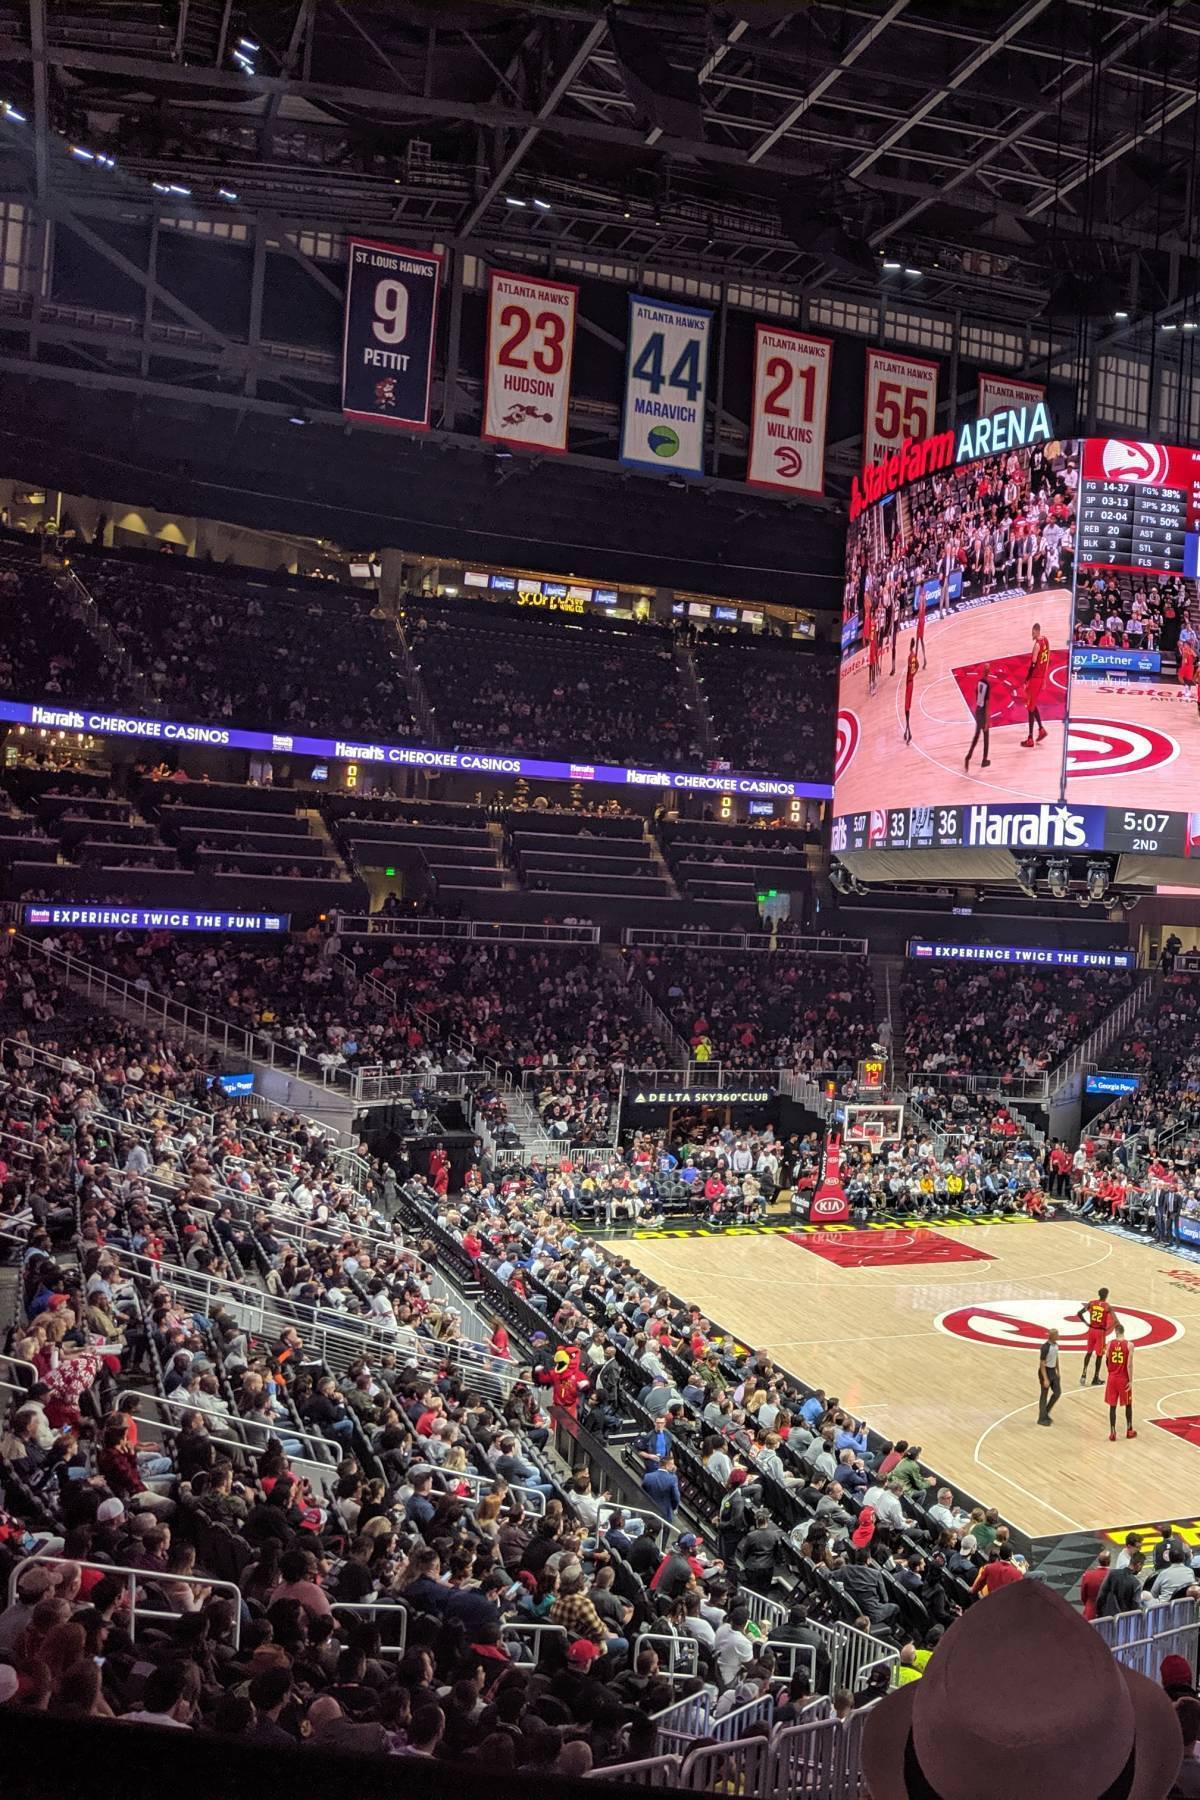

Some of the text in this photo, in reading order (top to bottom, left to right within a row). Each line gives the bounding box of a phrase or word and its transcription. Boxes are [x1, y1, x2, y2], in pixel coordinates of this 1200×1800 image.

[356, 252, 433, 277] ST. LOUIS HAWKS
[497, 282, 569, 306] ATLANTA HAWKS
[372, 279, 409, 344] 9
[637, 307, 705, 330] ATLANTA HAWKS
[499, 305, 565, 375] 23
[762, 336, 826, 358] ATLANTA HAWKS
[364, 348, 410, 372] PETTIT
[632, 332, 702, 402] 44
[874, 360, 933, 381] ATLANTA HAWKS
[504, 374, 554, 398] HUDSON
[764, 357, 816, 422] 21
[984, 384, 1040, 403] ATLANTA HAWKS
[635, 398, 696, 423] MARAVICH
[874, 381, 928, 440] 55
[767, 422, 813, 444] WILKINS
[956, 402, 1050, 463] ARENA
[1103, 482, 1129, 492] 14-37
[1162, 489, 1180, 499] 38%
[1102, 497, 1128, 507] 03-13
[1161, 504, 1179, 513] 23%
[1101, 511, 1127, 521] 02-04
[1160, 518, 1179, 528] 50%
[1084, 525, 1119, 535] REB 20
[1110, 541, 1116, 549] 3
[1139, 545, 1171, 555] STL 4
[1109, 555, 1115, 563] 7
[1164, 561, 1170, 569] 5
[1091, 654, 1133, 665] Partner
[89, 716, 161, 736] CHEROKEE
[164, 725, 229, 744] CASINOS
[389, 750, 457, 767] CHEROKEE
[461, 757, 521, 772] CASINOS
[674, 775, 737, 791] CHEROKEE
[740, 781, 795, 795] CASINOS
[853, 816, 866, 832] 5:07
[890, 813, 905, 836] 33
[938, 810, 956, 835] 36
[1123, 812, 1169, 833] 5:07
[1133, 838, 1158, 851] 2ND
[53, 910, 138, 924] EXPERIENCE
[144, 913, 189, 926] TWICE
[196, 916, 222, 927] THE
[228, 916, 261, 929] FUN!
[935, 947, 1010, 960] EXPERIENCE
[1015, 951, 1052, 962] TWICE
[1057, 953, 1078, 963] THE
[1084, 954, 1111, 965] FUN!
[865, 1063, 882, 1072] 5:07
[867, 1072, 879, 1084] 12
[1098, 1082, 1120, 1091] Georgia
[649, 1093, 690, 1102] DELTA
[820, 1202, 840, 1211] KIA
[633, 1216, 1038, 1239] ATLANTA HAWKS
[1091, 1311, 1103, 1322] 22
[1112, 1352, 1123, 1363] 25
